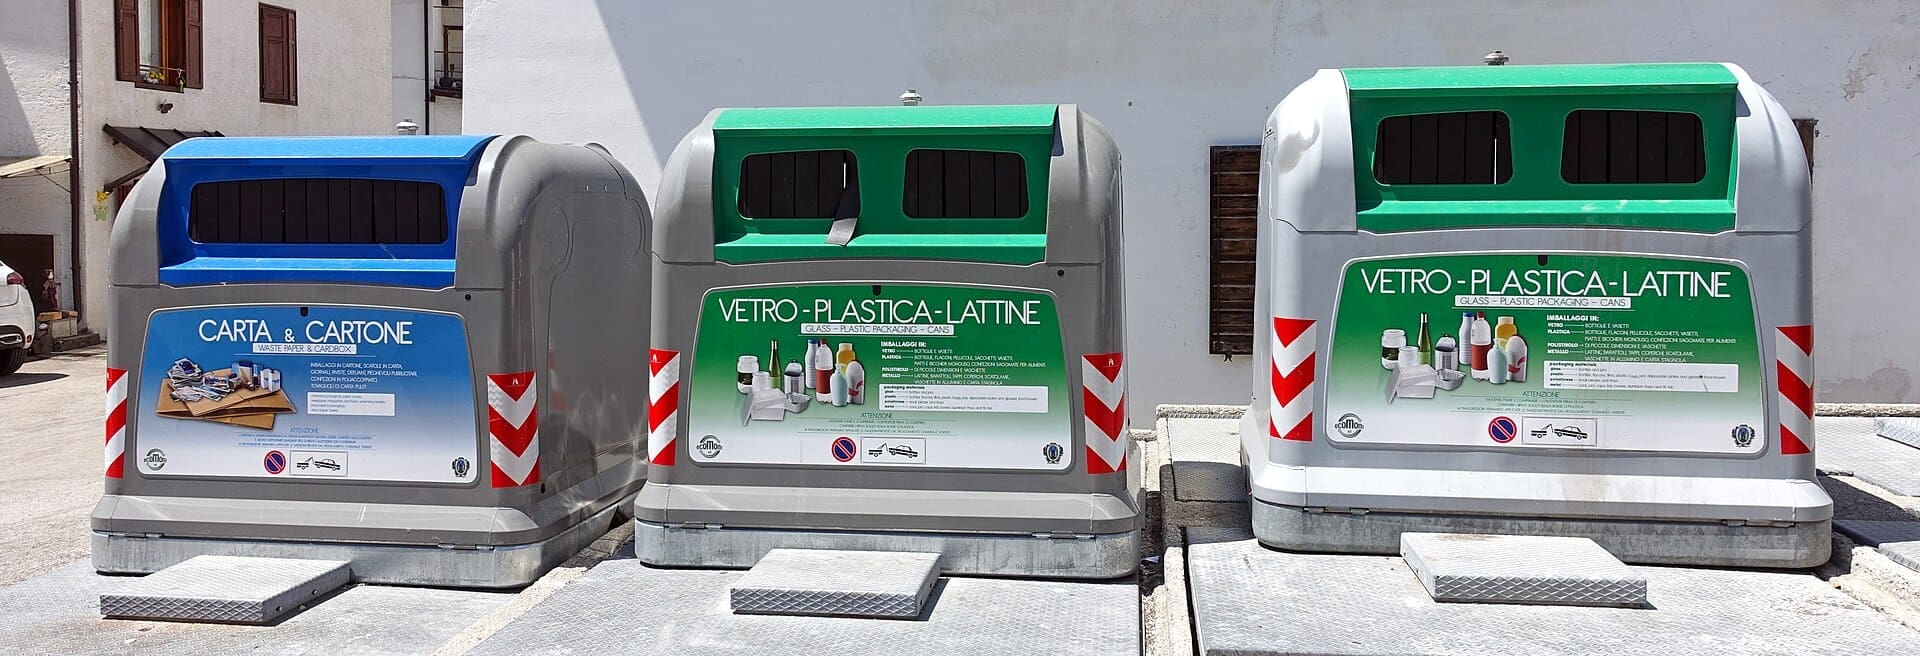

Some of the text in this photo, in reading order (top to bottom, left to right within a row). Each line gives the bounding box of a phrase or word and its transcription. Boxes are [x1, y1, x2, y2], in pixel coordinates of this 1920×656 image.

[1360, 268, 1452, 294] VETRO
[1471, 269, 1607, 296] PLASTICA
[1623, 270, 1731, 298] LATTINE
[1460, 297, 1490, 305] GLASS
[1500, 297, 1534, 306] PLASTIC
[1537, 298, 1589, 306] PACKAGING
[1600, 299, 1626, 307] CANS
[719, 298, 798, 322] VETRO
[814, 299, 933, 324] PLASTICA
[946, 300, 1041, 325] LATTINE
[199, 320, 413, 345] CARTA & CARTONE
[805, 325, 831, 333] GLASS
[840, 325, 871, 333] PLASTIC
[872, 326, 918, 334] PACKAGING
[928, 326, 950, 334] CANS
[258, 344, 282, 352] WASTE
[284, 344, 304, 352] PAPER
[314, 345, 352, 353] CARDBOX
